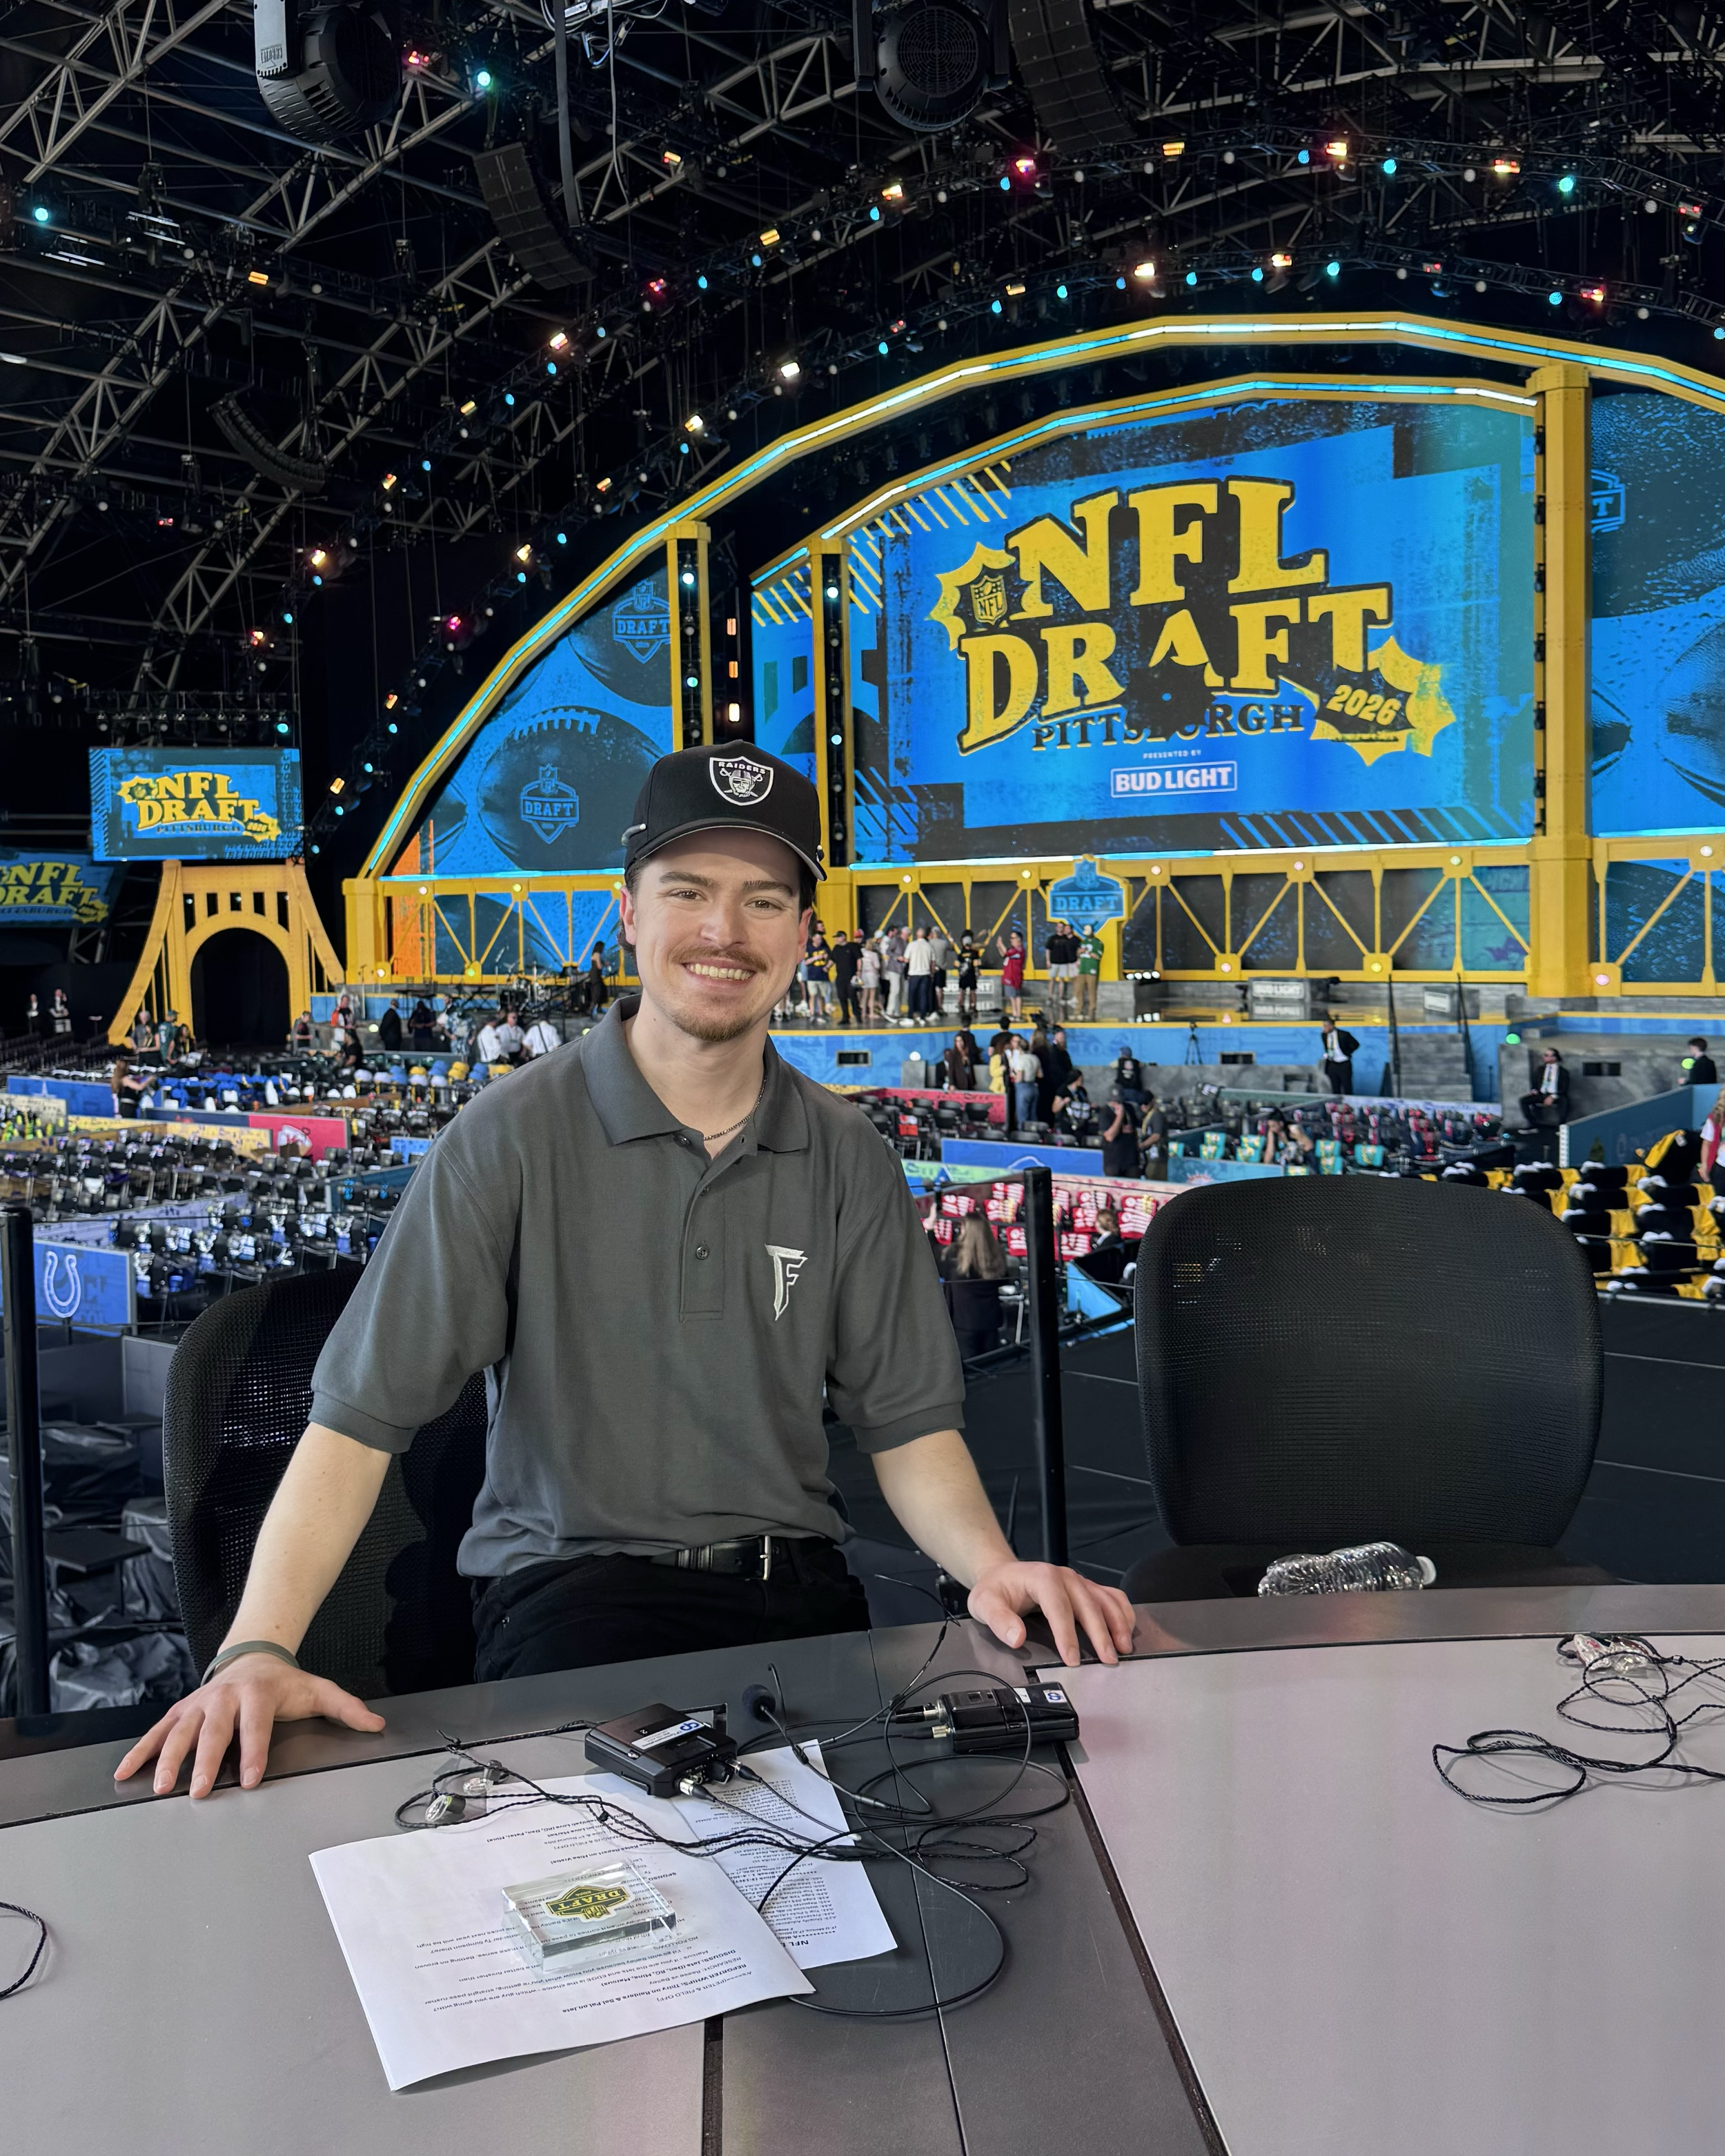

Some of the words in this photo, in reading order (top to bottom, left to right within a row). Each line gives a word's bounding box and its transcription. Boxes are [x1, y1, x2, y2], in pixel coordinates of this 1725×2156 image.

[1005, 478, 1327, 620] NFL
[978, 593, 1004, 617] NFL
[617, 619, 669, 634] DRAFT
[958, 586, 1390, 749] DRAFT
[1331, 684, 1402, 726] 2026
[1142, 750, 1188, 760] PRESENTED
[1190, 749, 1202, 758] BY
[718, 762, 766, 775] RAIDERS
[156, 772, 239, 800] NFL
[1115, 771, 1161, 793] BUD
[1165, 767, 1232, 789] LIGHT
[137, 799, 259, 829] DRAFT
[524, 801, 573, 816] DRAFT
[6, 862, 83, 887] NFL
[1056, 896, 1118, 911] DRAFT
[556, 1889, 620, 1910] DRAFT
[701, 1949, 736, 1963] DISCUSS:
[701, 1957, 741, 1972] RESEARCH:
[709, 1964, 746, 1979] REPORTER
[622, 1991, 650, 1999] Raiders
